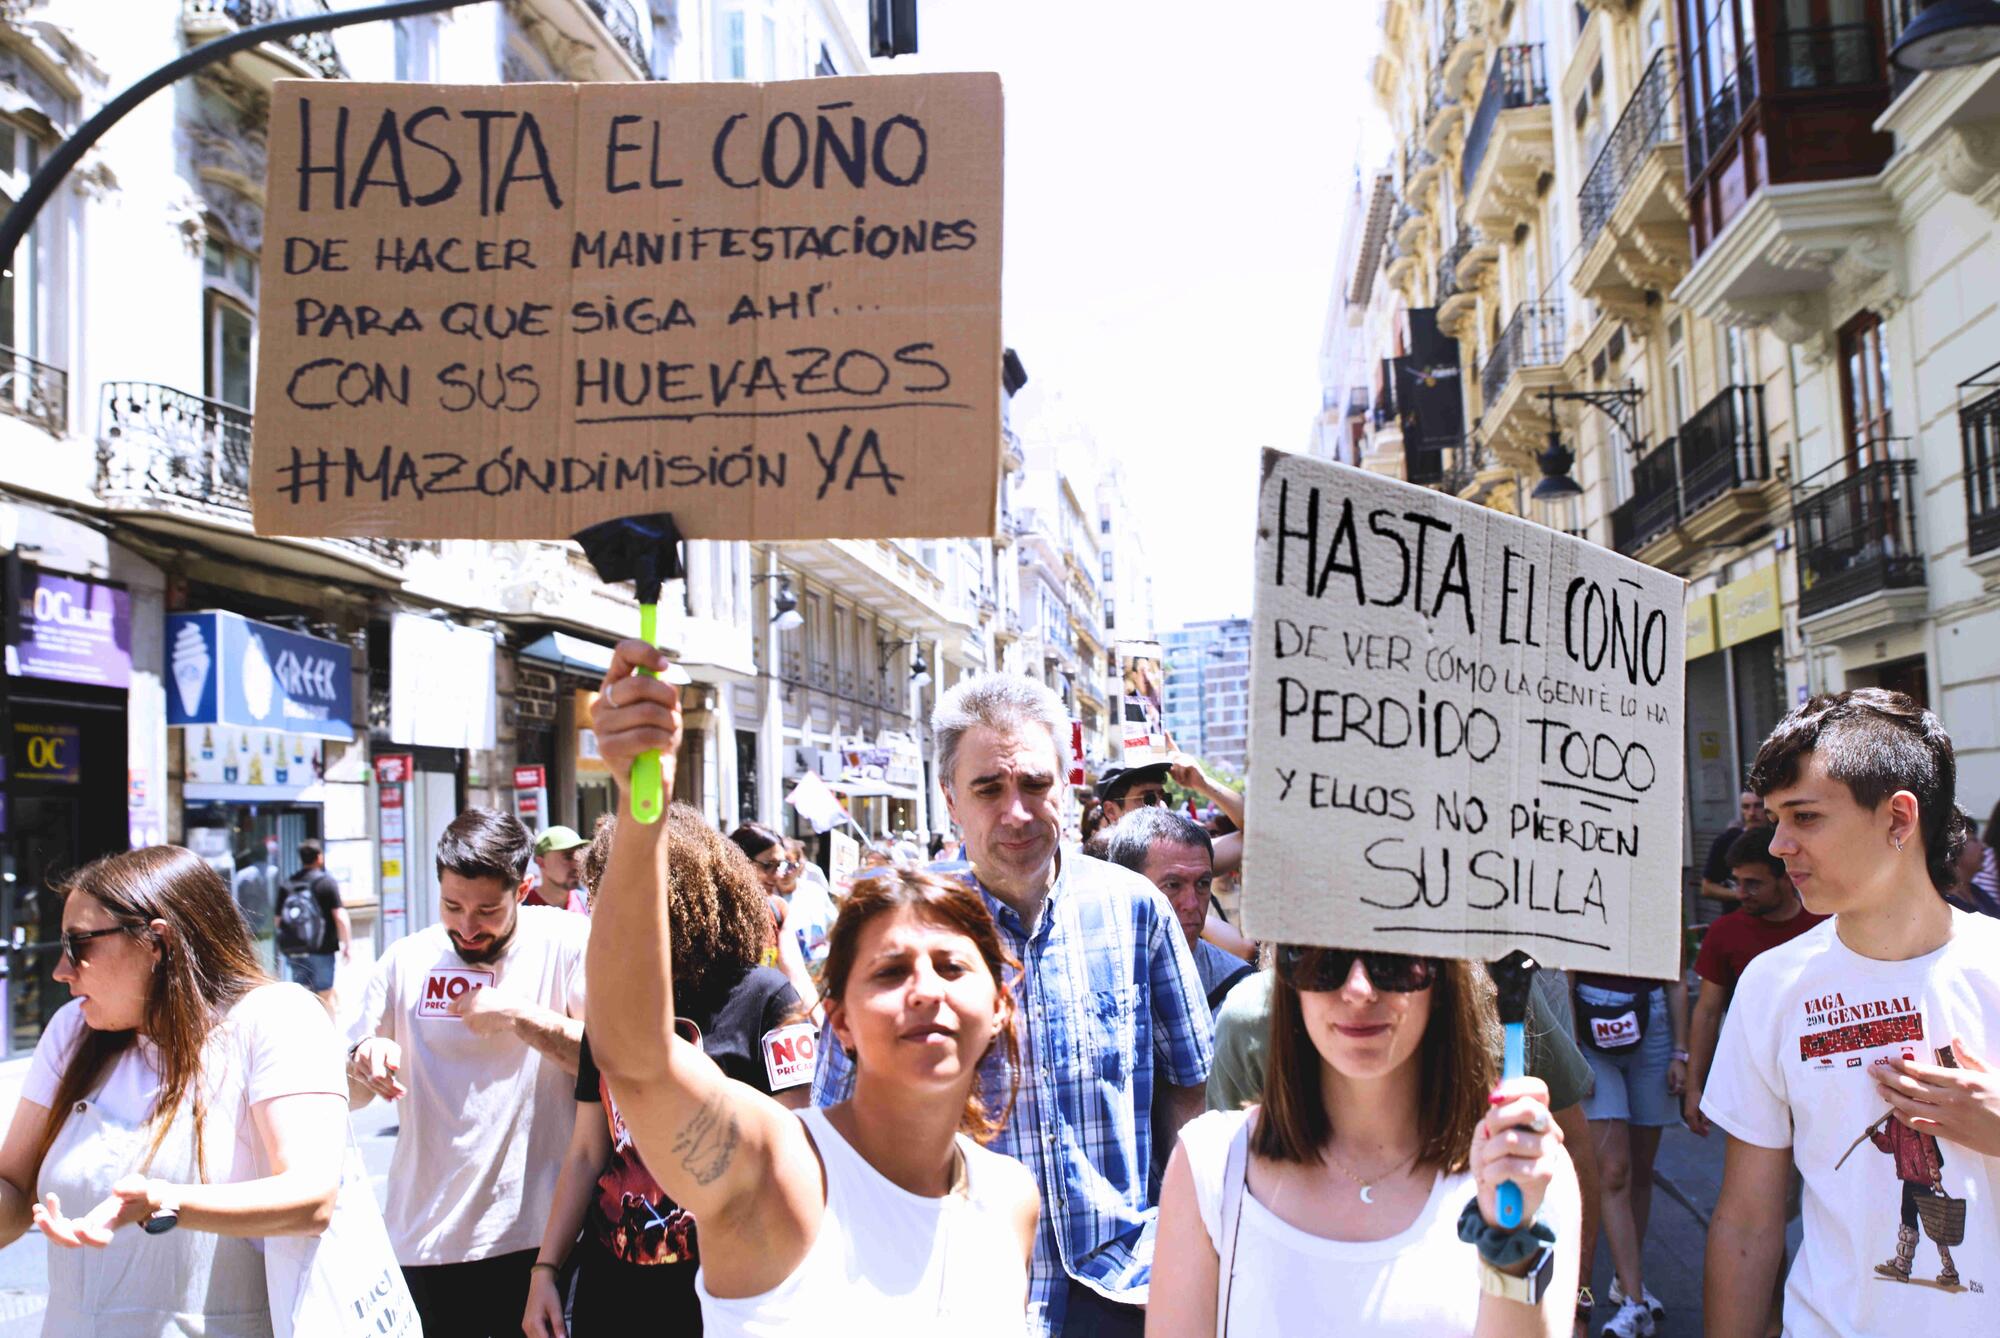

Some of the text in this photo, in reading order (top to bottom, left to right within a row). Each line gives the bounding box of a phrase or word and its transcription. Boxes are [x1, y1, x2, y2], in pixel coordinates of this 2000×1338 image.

[296, 97, 928, 217] HASTA EL COÑO
[284, 237, 349, 275] DE
[376, 237, 537, 274] HACER
[295, 298, 424, 340] PARA
[440, 302, 553, 341] QUE
[286, 343, 950, 412] CON SUS HUEVAZOS
[806, 425, 905, 500] YA
[1276, 478, 1667, 686] HASTA EL COÑO
[1275, 619, 1328, 661] DE
[1343, 631, 1411, 673] VER
[1505, 668, 1531, 695] LA
[1620, 695, 1637, 717] LO
[1646, 703, 1671, 726] HA
[27, 735, 66, 770] OC
[1526, 718, 1656, 792] TODO
[1276, 767, 1297, 801] Y
[1310, 772, 1415, 821] ELLOS
[1436, 790, 1489, 834] NO
[1360, 837, 1608, 925] SU SILLA
[1804, 992, 1844, 1015] VAGA
[1806, 996, 1916, 1027] 29M GENERAL
